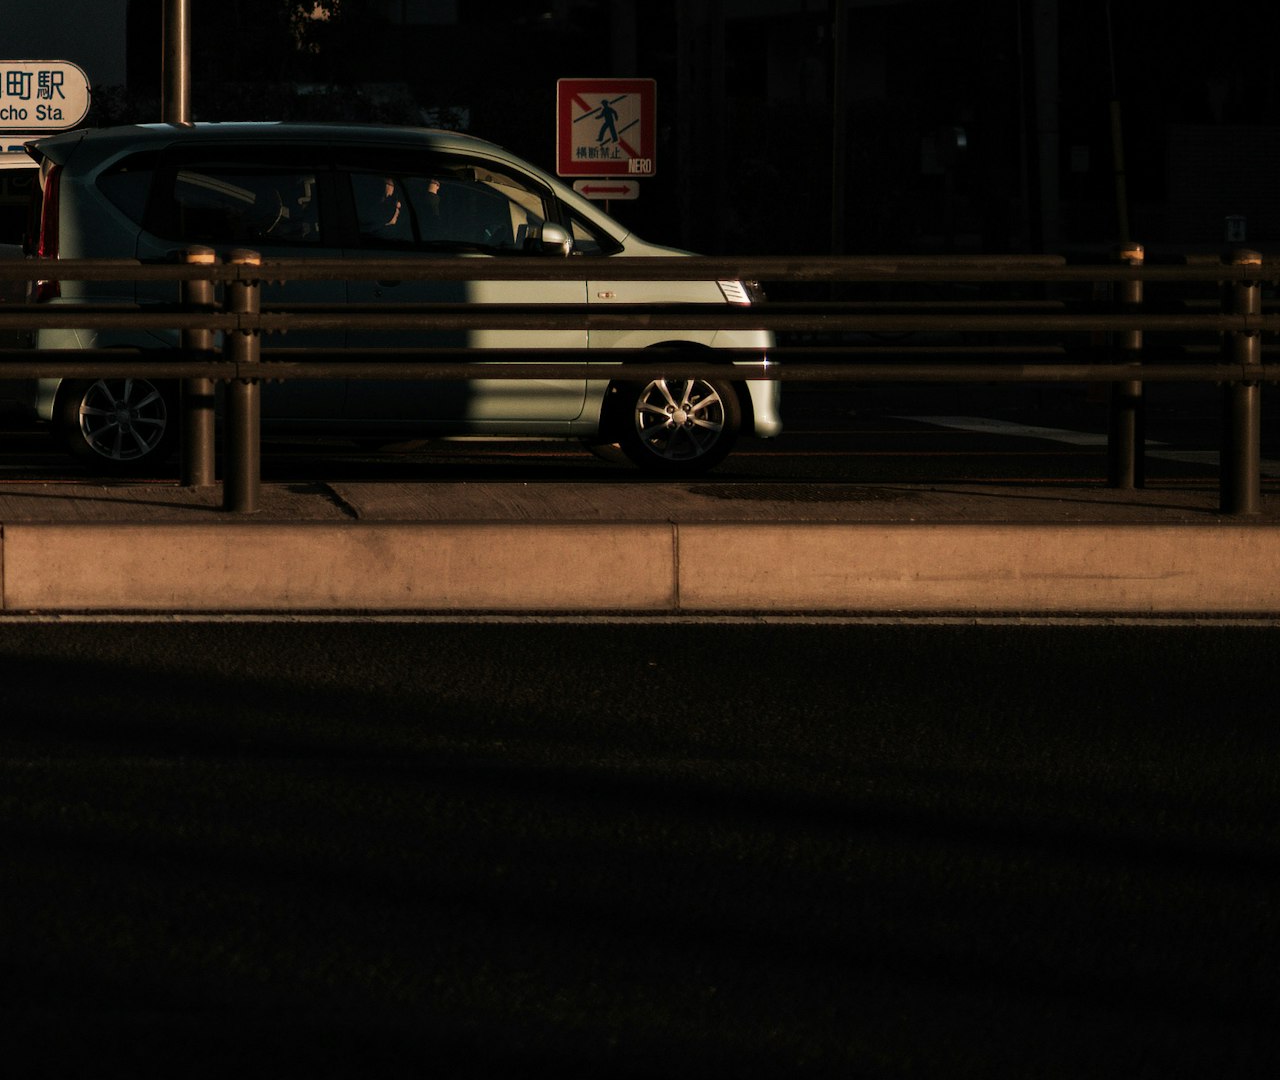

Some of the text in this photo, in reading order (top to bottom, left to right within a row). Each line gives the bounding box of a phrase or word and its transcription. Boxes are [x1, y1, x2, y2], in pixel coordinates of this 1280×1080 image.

[35, 104, 65, 121] Sta.
[576, 146, 622, 160] 横断禁止
[628, 158, 652, 174] NERO
